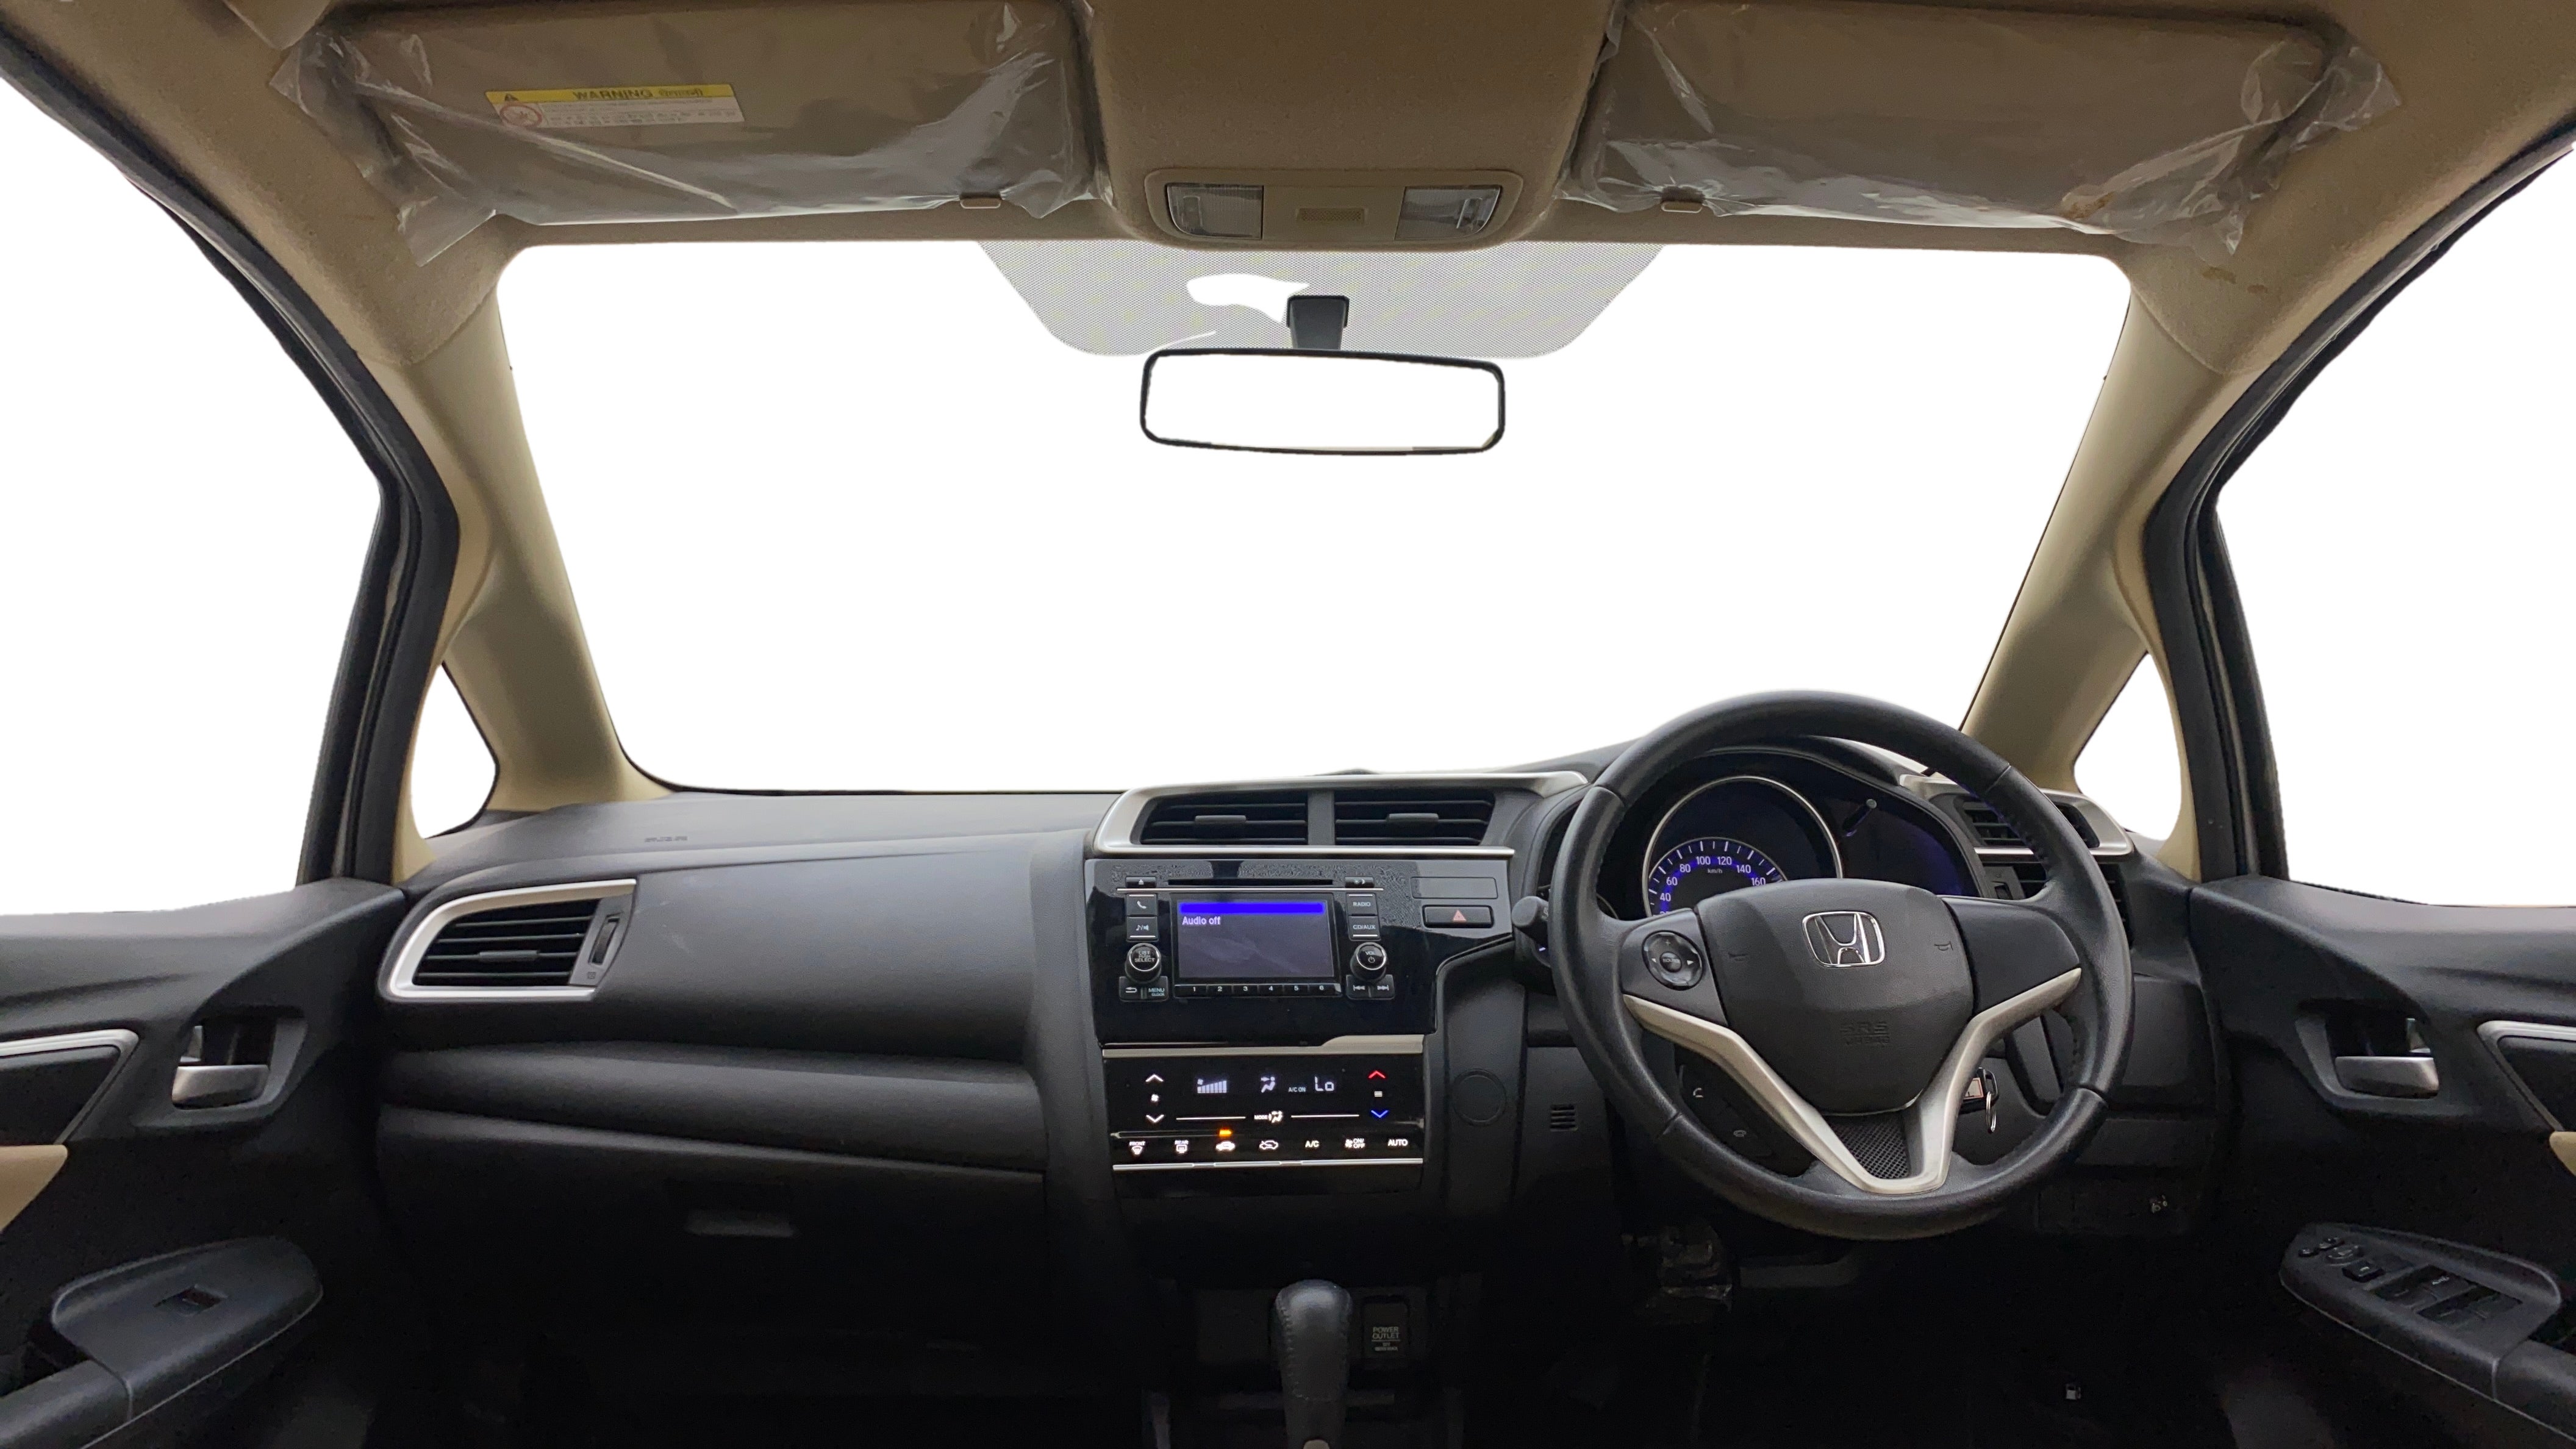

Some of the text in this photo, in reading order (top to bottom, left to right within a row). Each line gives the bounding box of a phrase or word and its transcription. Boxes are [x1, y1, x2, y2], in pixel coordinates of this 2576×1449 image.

[572, 90, 653, 100] WARNING
[1696, 856, 1711, 865] 100
[1717, 856, 1732, 865] 120
[1680, 864, 1690, 873] 80
[1736, 864, 1751, 873] 140
[1666, 876, 1677, 886] 60
[1751, 877, 1766, 886] 160
[1660, 892, 1671, 901] 40
[1182, 916, 1221, 925] Audio off
[1314, 1076, 1334, 1091] Lo
